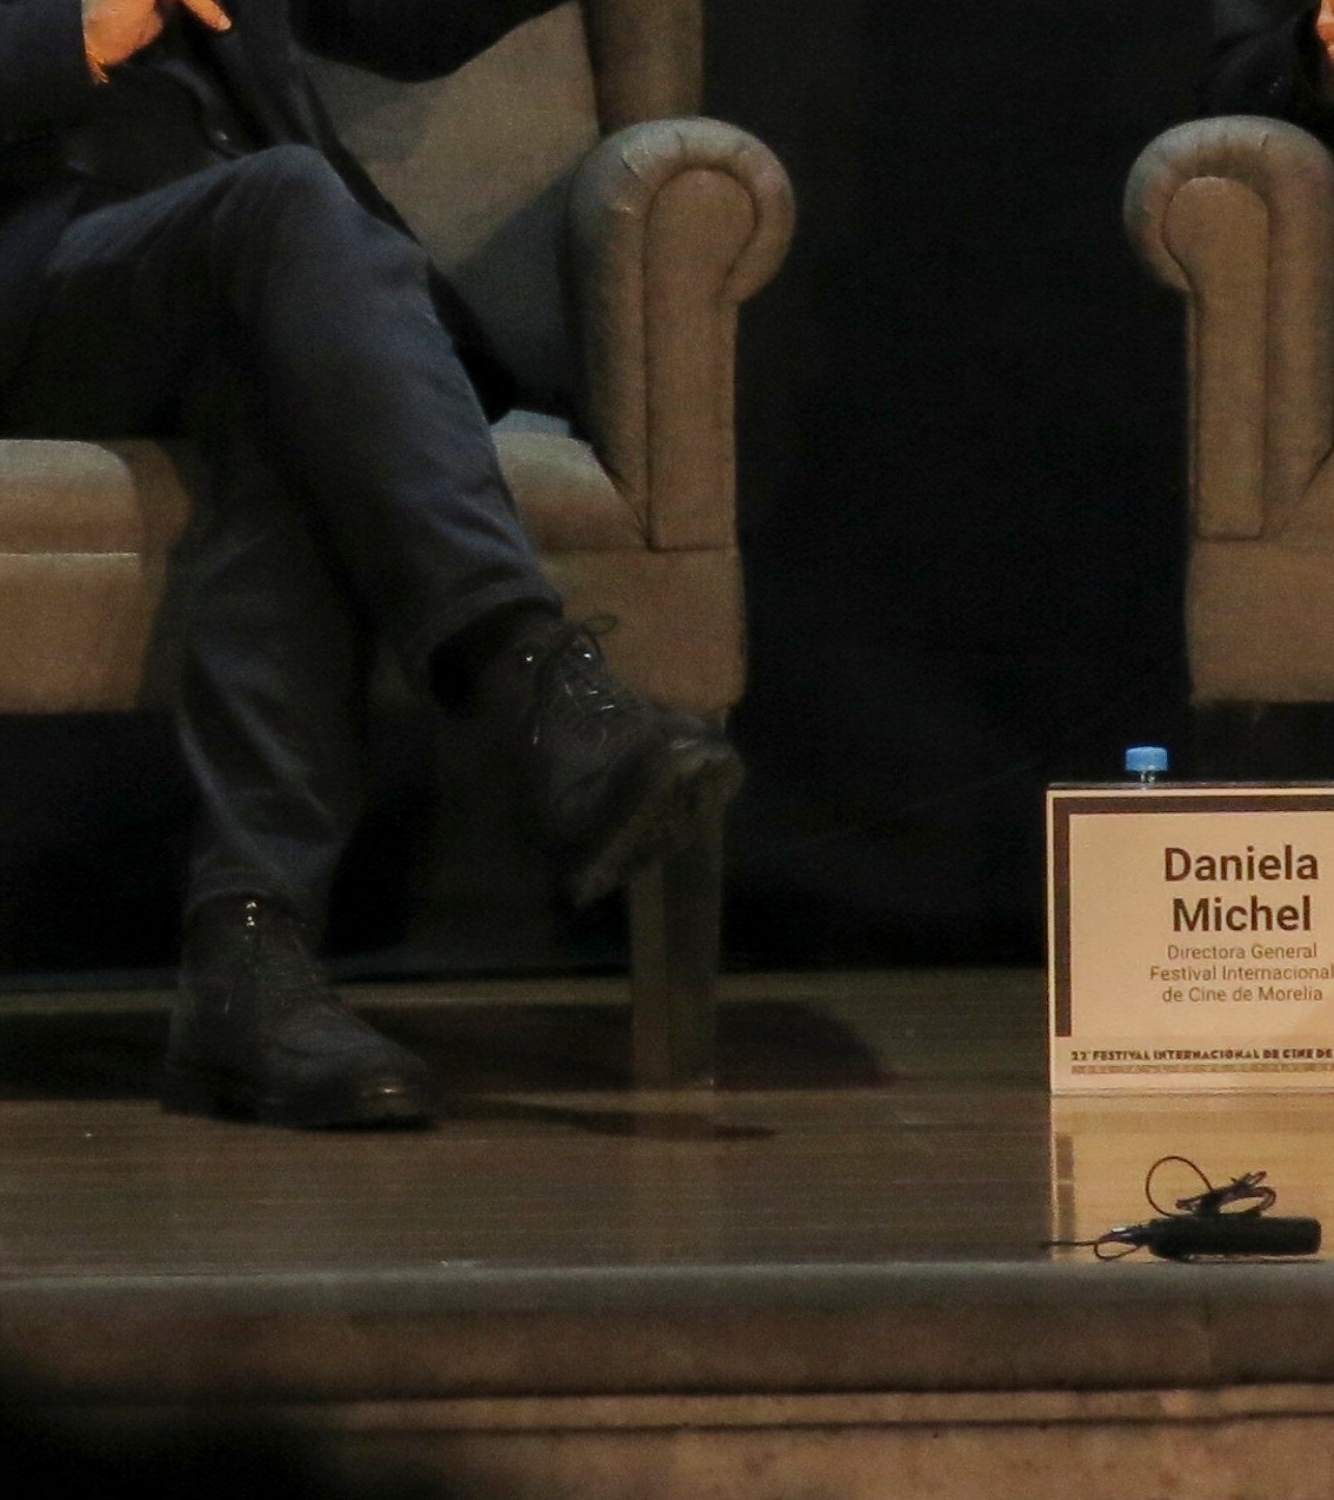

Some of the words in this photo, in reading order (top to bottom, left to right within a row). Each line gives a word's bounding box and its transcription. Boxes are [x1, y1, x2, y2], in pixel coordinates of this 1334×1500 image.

[1164, 844, 1319, 882] Daniela
[1172, 894, 1312, 932] Michel
[1167, 944, 1246, 960] Directora
[1250, 942, 1318, 960] General
[1149, 965, 1217, 982] Festival
[1222, 963, 1334, 981] Internacional
[1162, 987, 1183, 1003] de
[1188, 985, 1227, 1003] Cine
[1232, 987, 1253, 1002] de
[1258, 986, 1323, 1002] Morelia
[1092, 1050, 1151, 1061] FESTIVAL
[1154, 1049, 1260, 1060] INTERNACIONAL
